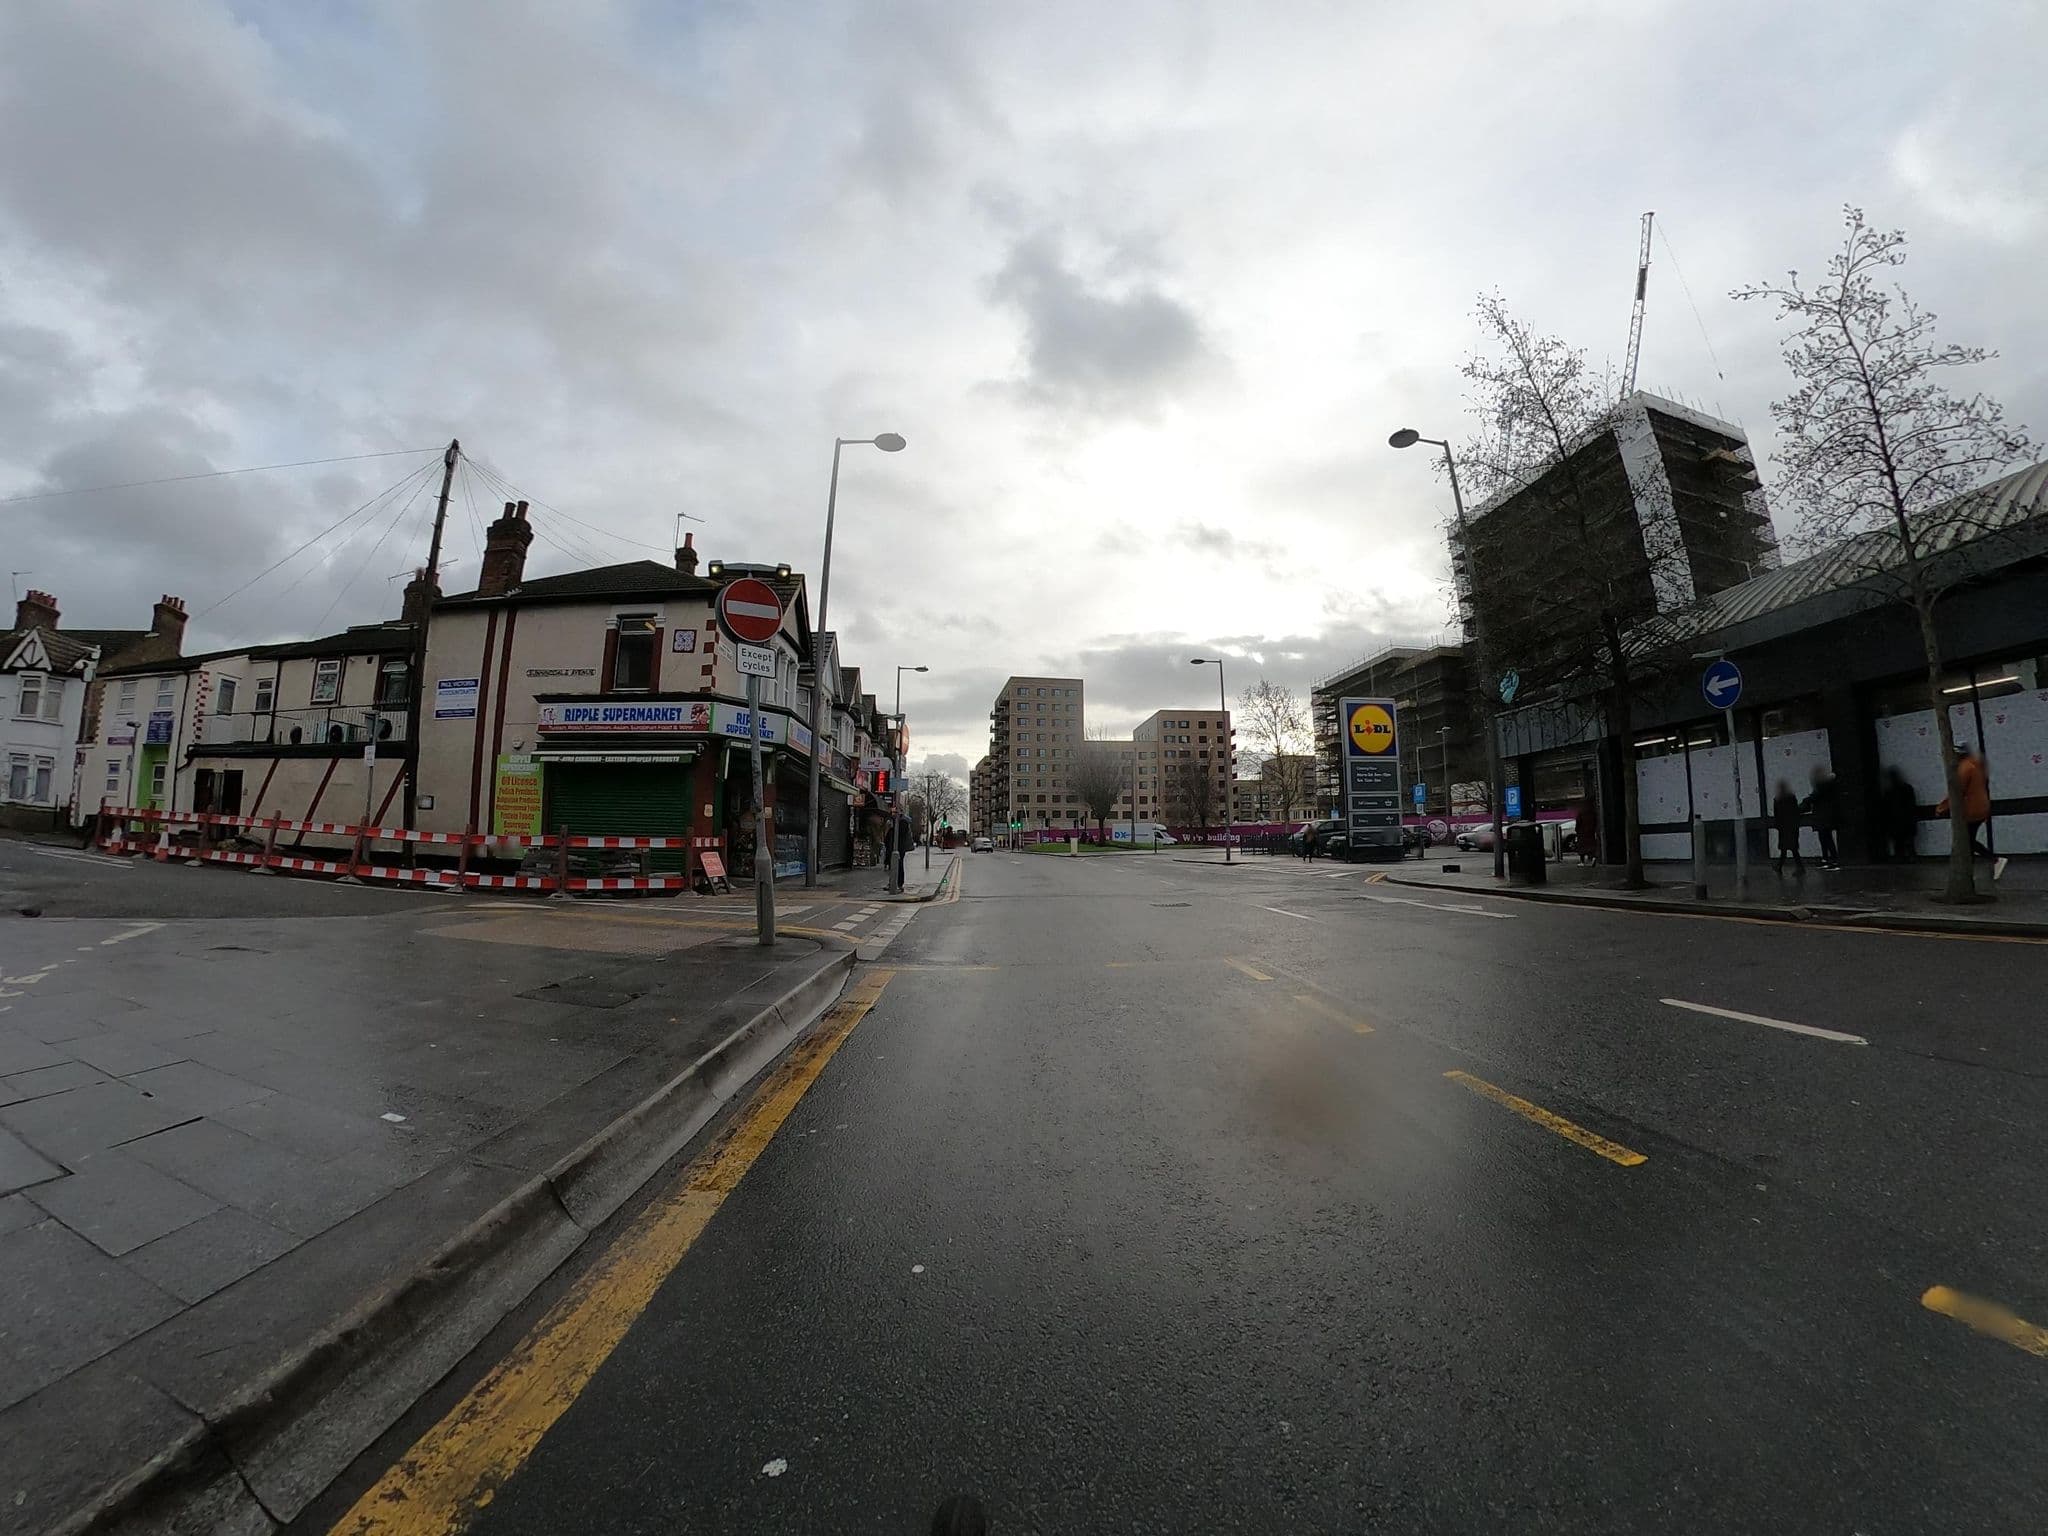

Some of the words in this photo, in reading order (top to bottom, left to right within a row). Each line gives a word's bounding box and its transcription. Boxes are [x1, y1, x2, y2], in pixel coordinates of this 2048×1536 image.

[741, 648, 772, 661] Except
[742, 661, 771, 673] cycles
[564, 707, 599, 721] RIPPLE
[602, 707, 682, 721] SUPERMARKET
[736, 712, 767, 728] RIPLE
[1114, 831, 1126, 839] DX
